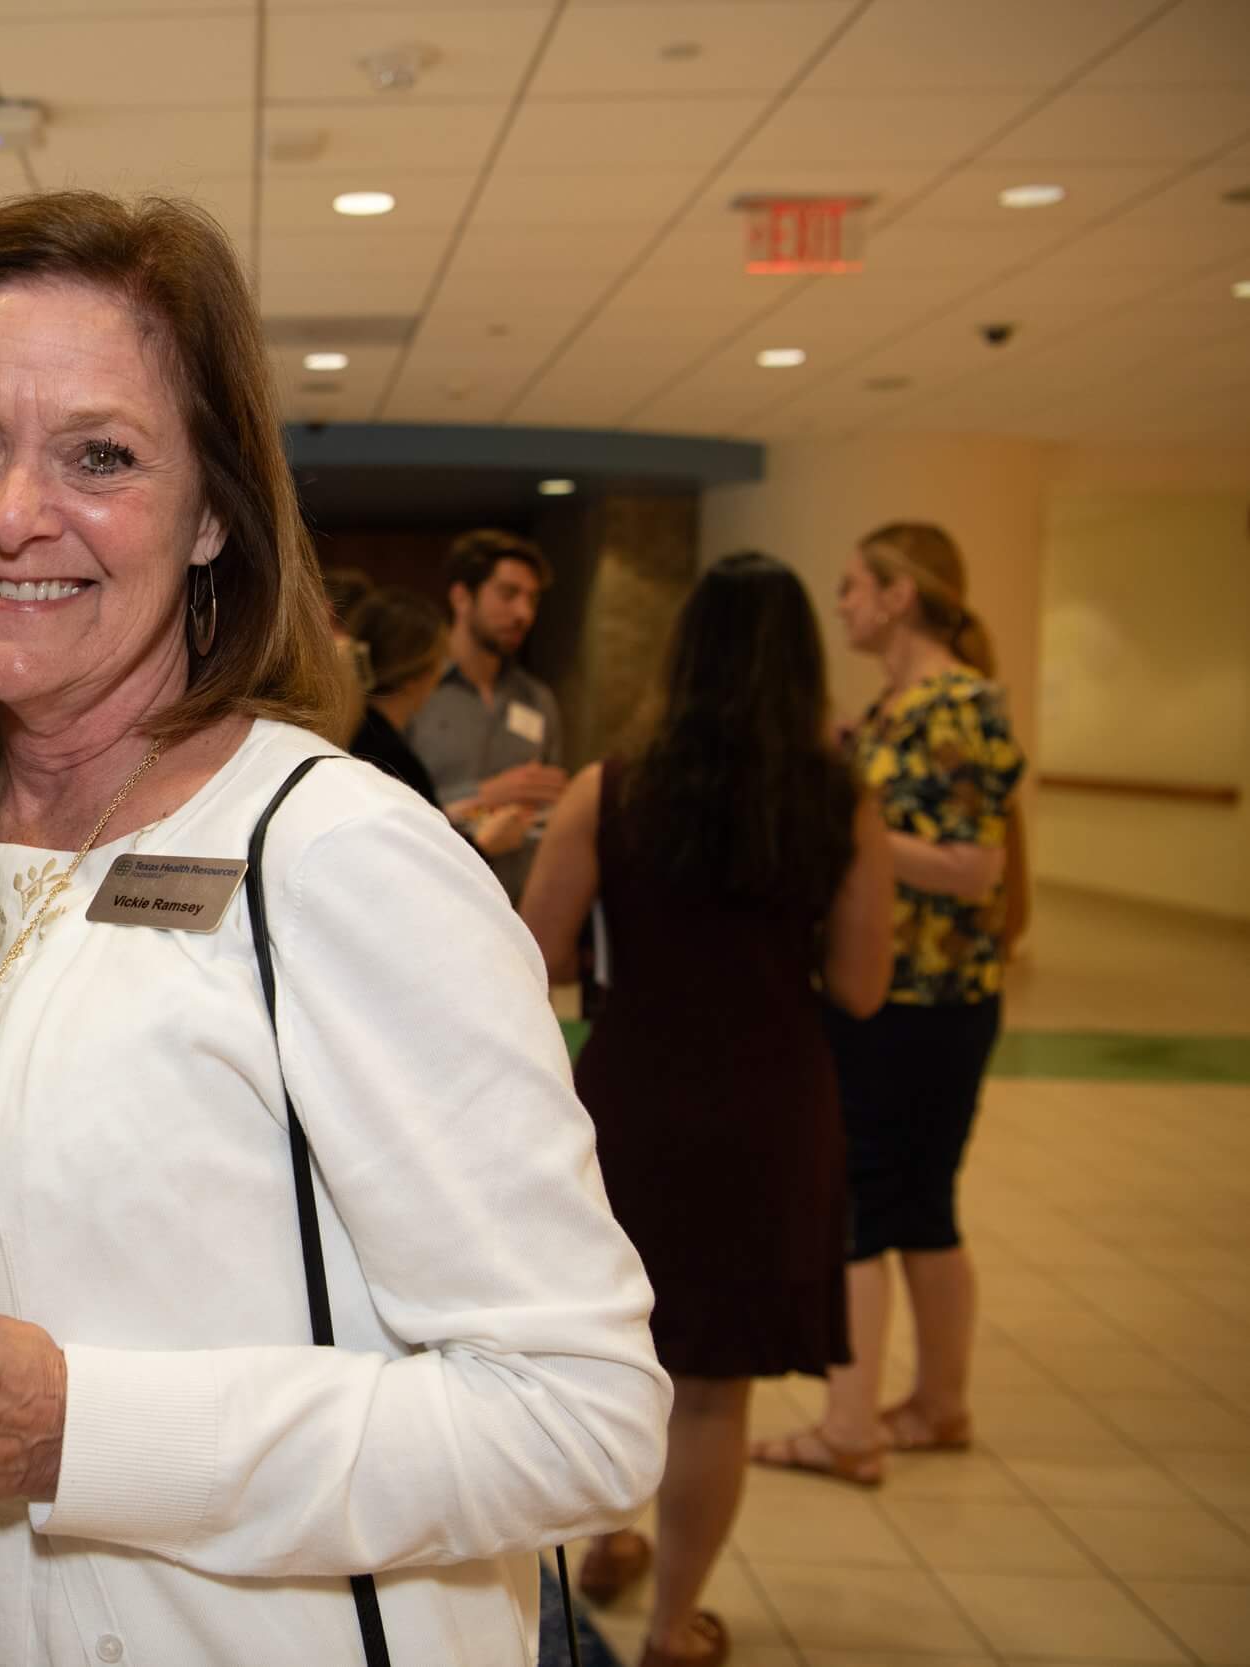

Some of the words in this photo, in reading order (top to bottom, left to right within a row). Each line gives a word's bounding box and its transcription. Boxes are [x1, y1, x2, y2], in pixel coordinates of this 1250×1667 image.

[770, 202, 846, 261] EXIT
[134, 861, 159, 872] Texas
[159, 863, 191, 873] Health
[190, 865, 239, 877] Resources
[113, 895, 150, 909] Vickie
[152, 898, 205, 916] Ramsey
